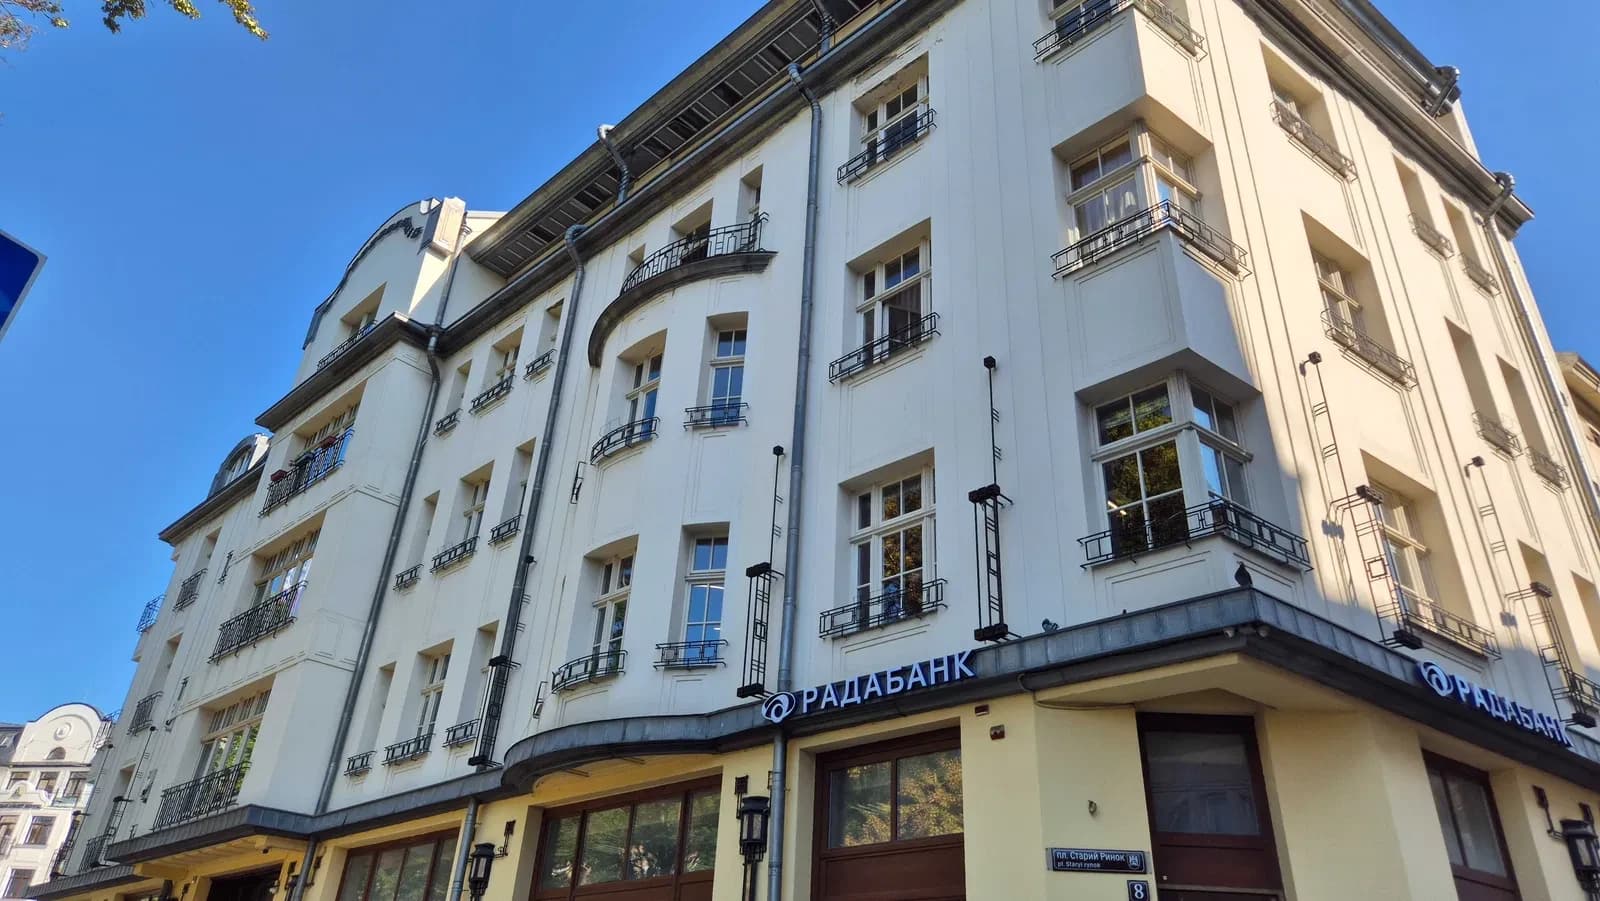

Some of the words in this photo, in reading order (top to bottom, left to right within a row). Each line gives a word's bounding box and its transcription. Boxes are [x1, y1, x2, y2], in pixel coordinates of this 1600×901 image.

[802, 650, 976, 714] РАДАБАНК
[1454, 674, 1574, 747] РАДАБАНК
[1070, 852, 1099, 861] Старий
[1100, 853, 1126, 861] Ринок
[1134, 883, 1144, 899] 8
